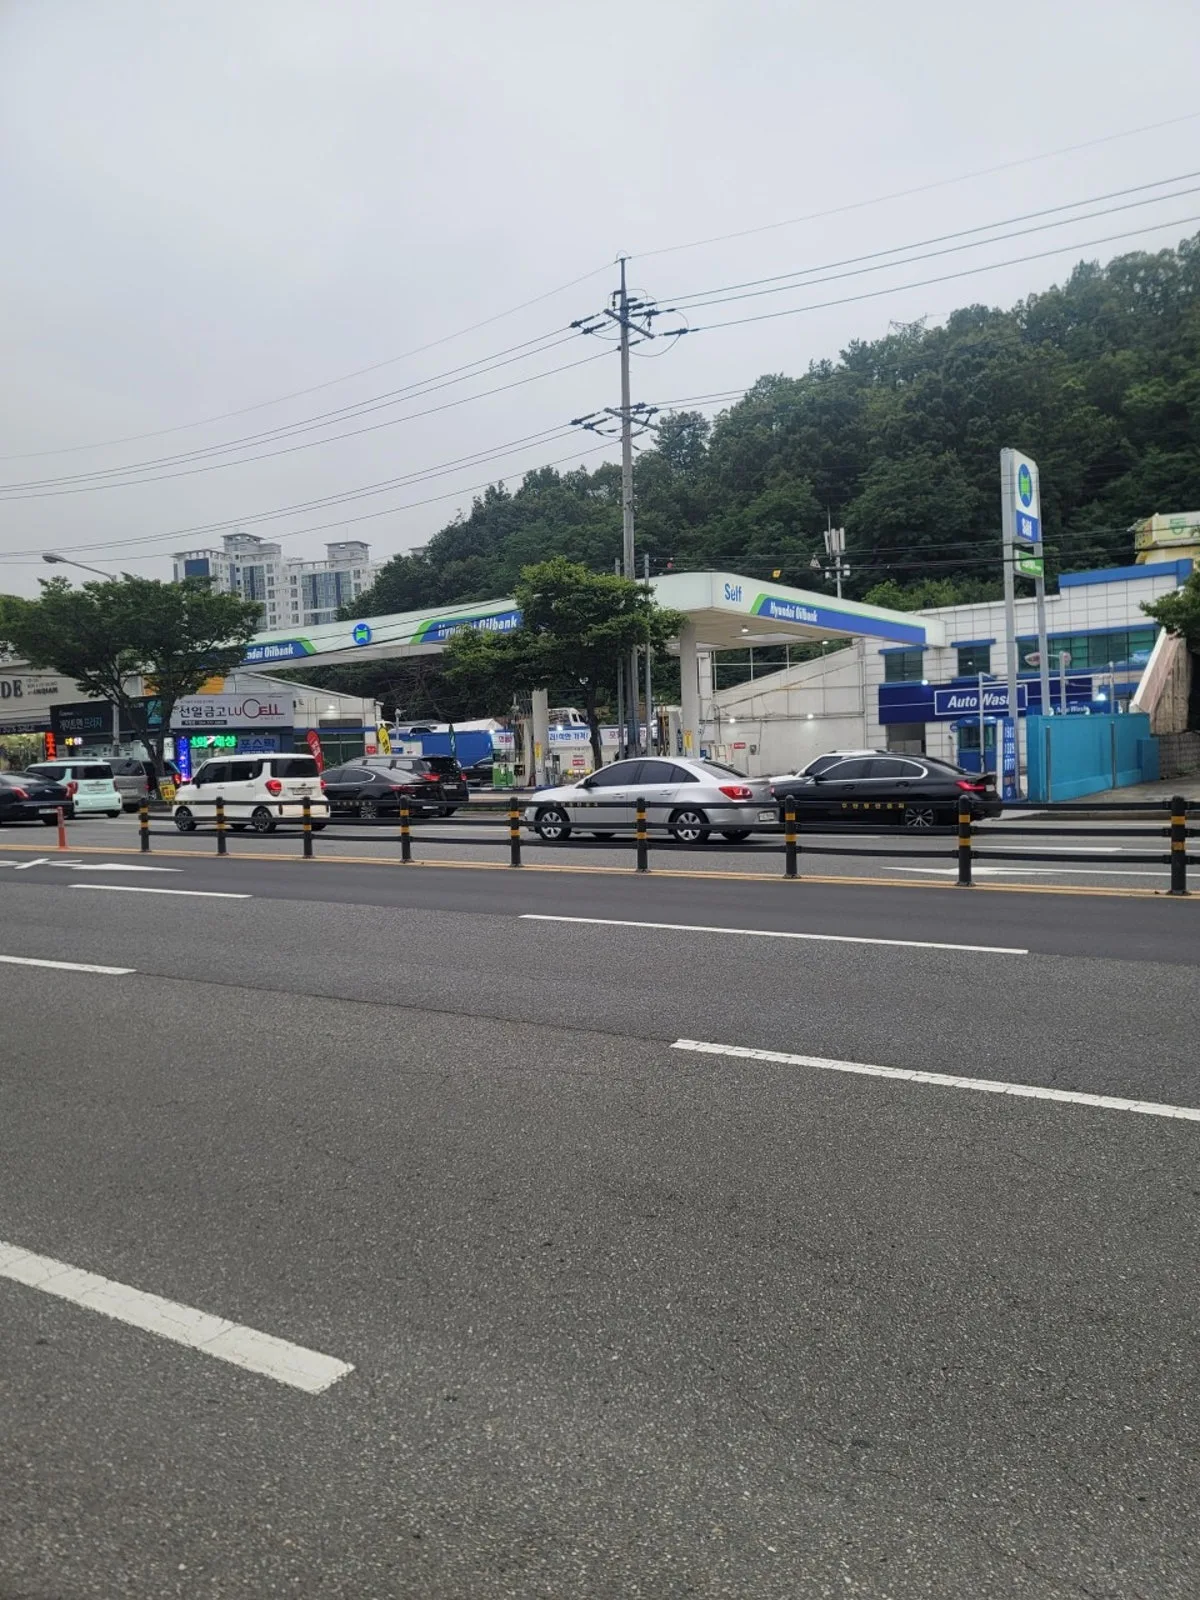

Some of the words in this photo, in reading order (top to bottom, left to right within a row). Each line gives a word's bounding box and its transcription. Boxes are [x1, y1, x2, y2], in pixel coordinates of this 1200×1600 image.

[724, 583, 742, 601] Self
[769, 601, 795, 617] Hyundai
[795, 605, 818, 622] Oilbank
[947, 695, 978, 709] Auto
[982, 692, 1010, 706] Was
